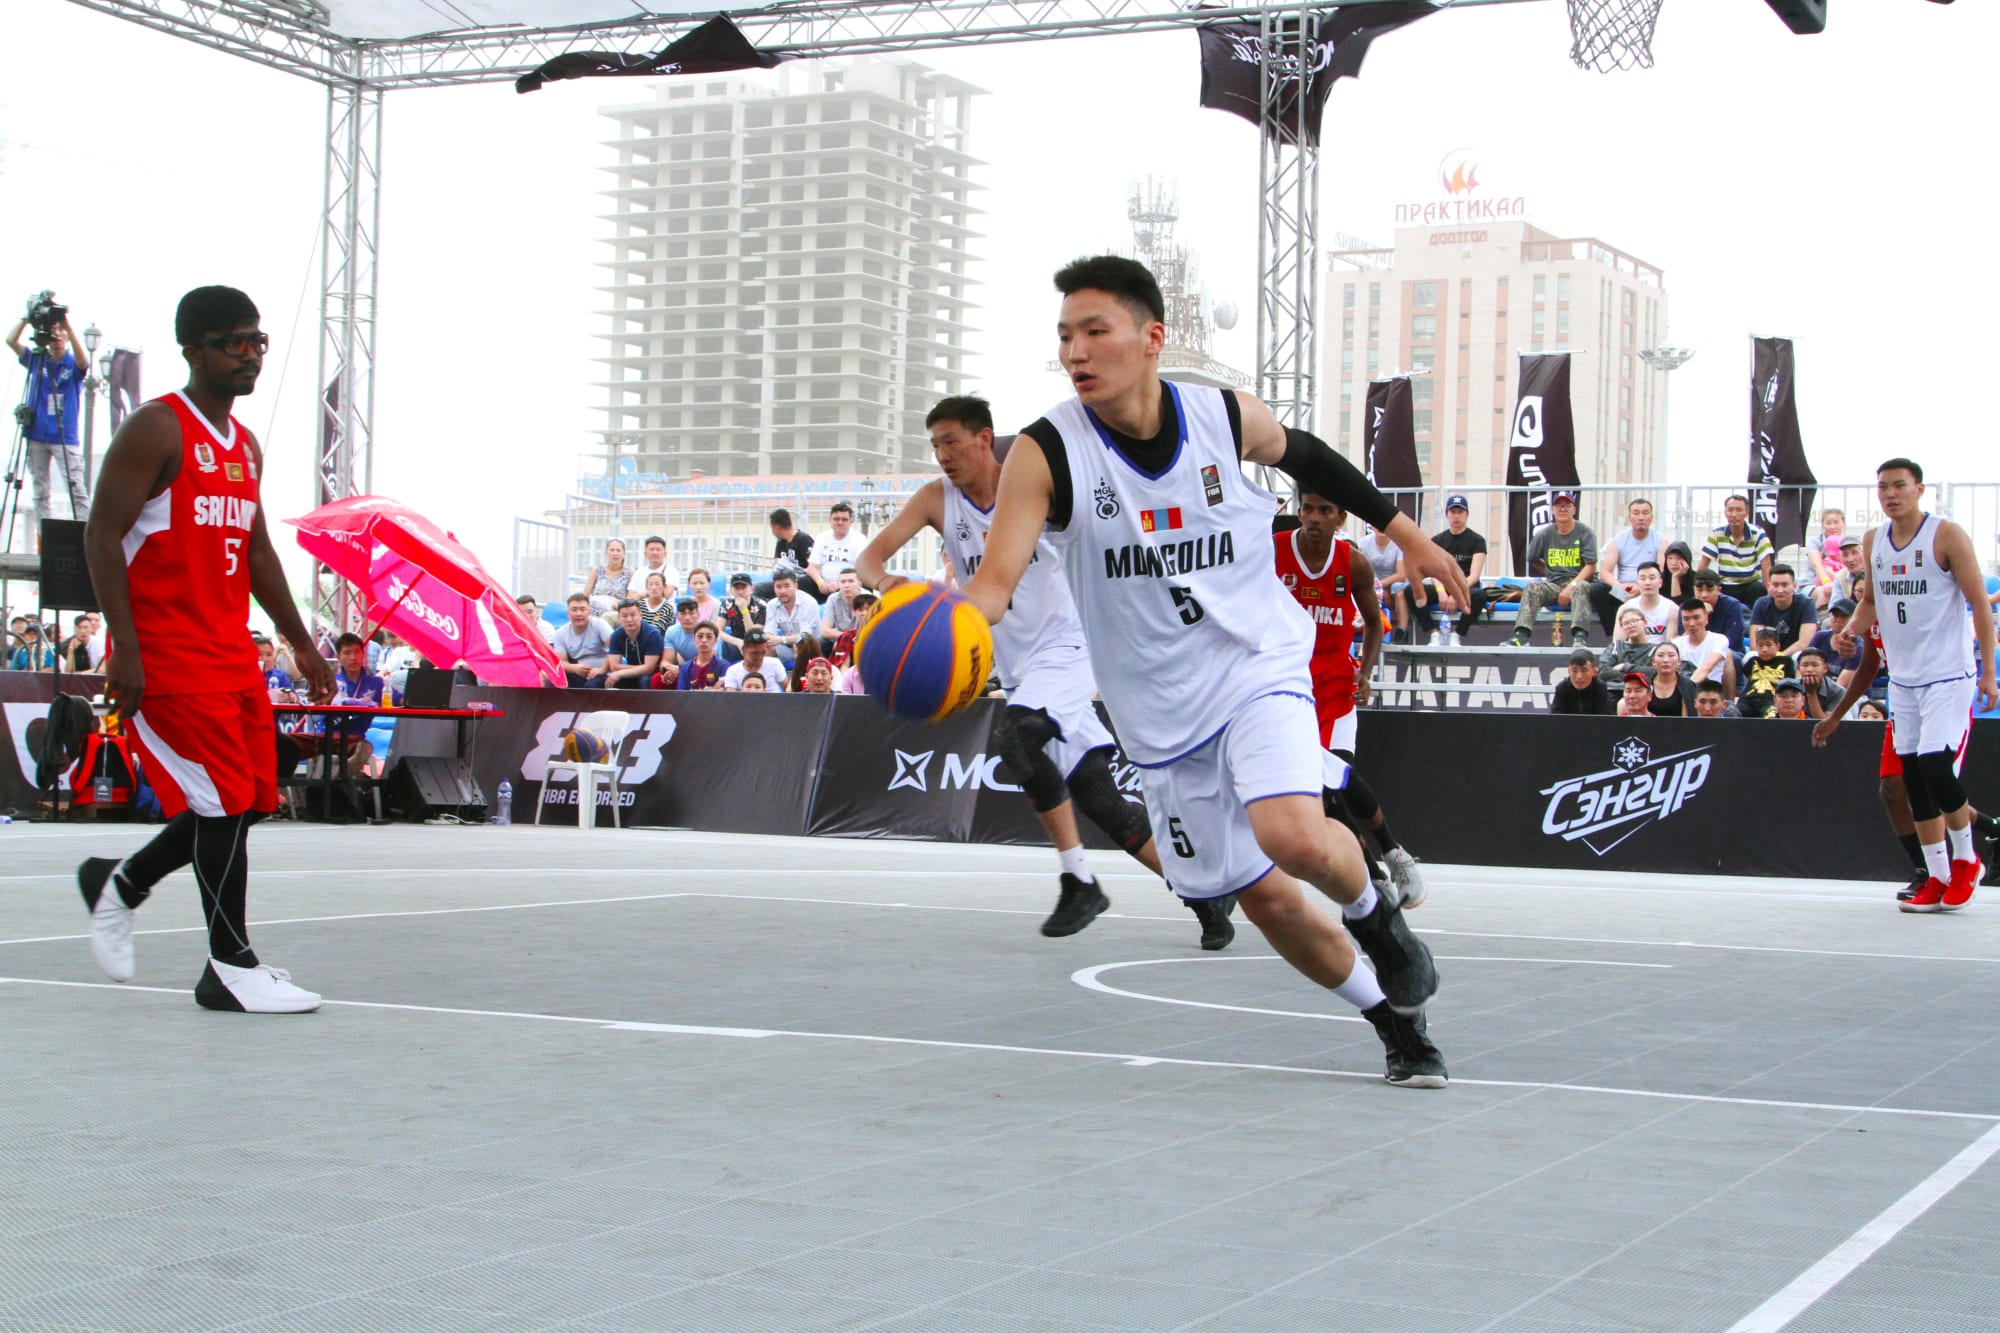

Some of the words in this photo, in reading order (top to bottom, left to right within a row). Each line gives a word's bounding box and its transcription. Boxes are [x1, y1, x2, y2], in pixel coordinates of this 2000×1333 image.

[1395, 197, 1526, 225] ПРАКТИКАЛ
[1094, 486, 1115, 497] MGL
[194, 496, 225, 527] SRI
[225, 538, 242, 576] 5
[1104, 531, 1235, 579] MONGOLIA
[1880, 580, 1927, 596] MONGOLIA
[1169, 586, 1204, 626] 5
[1306, 604, 1344, 626] ANKA
[1897, 601, 1907, 624] 6
[543, 788, 567, 804] IBA
[568, 789, 636, 807] EORED
[1168, 816, 1195, 858] 5
